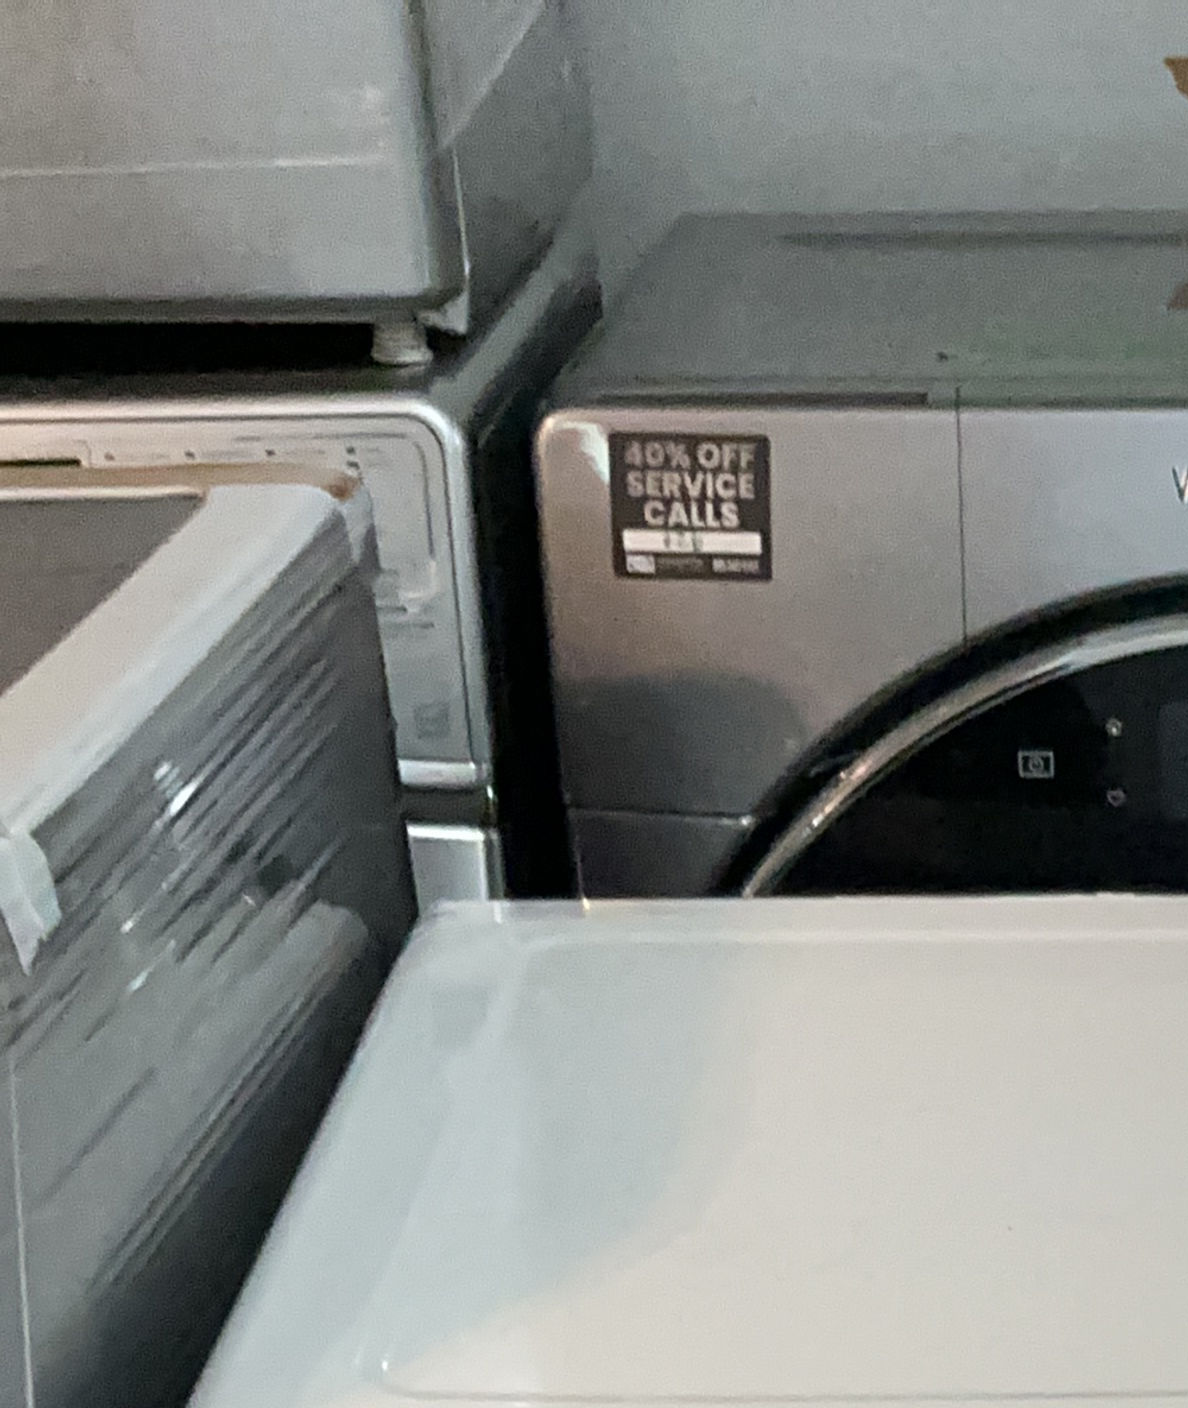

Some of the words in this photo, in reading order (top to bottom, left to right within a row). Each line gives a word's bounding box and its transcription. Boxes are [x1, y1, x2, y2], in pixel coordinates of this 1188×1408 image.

[623, 441, 691, 469] 40%
[697, 442, 755, 470] OFF
[626, 471, 755, 499] SERVICE
[643, 502, 740, 528] CALLS
